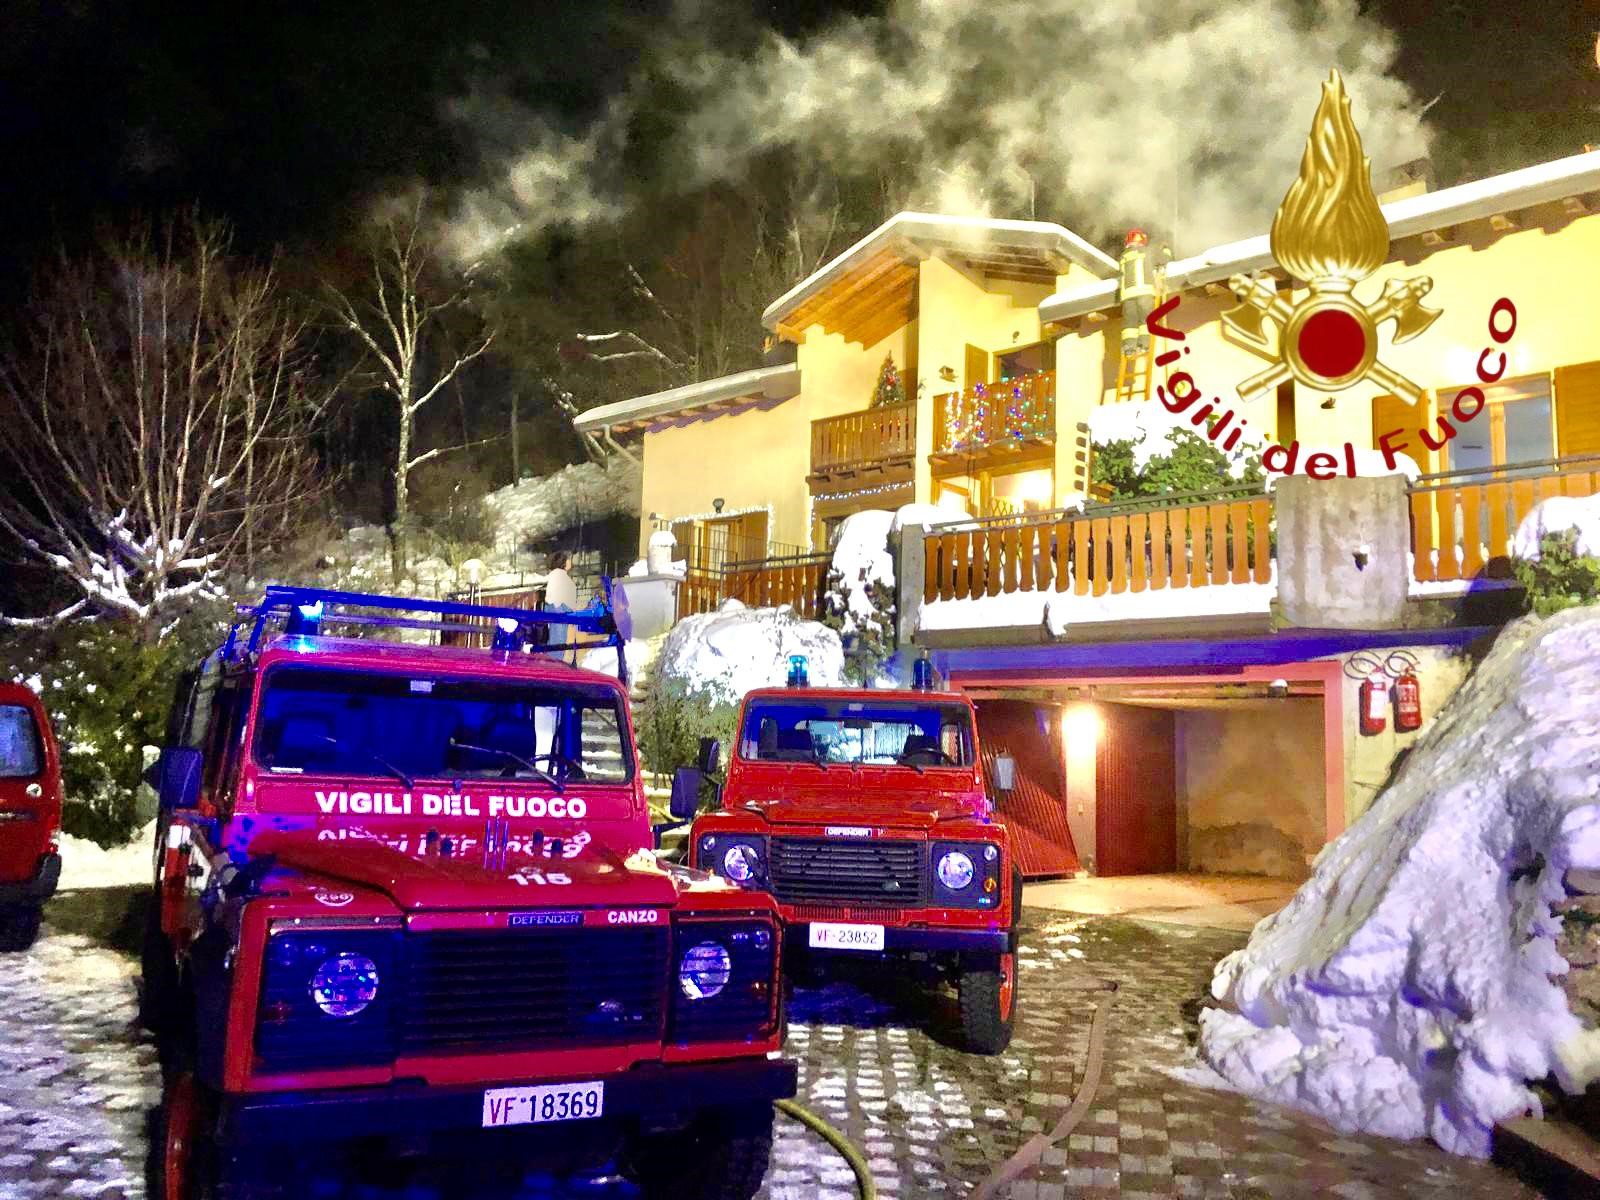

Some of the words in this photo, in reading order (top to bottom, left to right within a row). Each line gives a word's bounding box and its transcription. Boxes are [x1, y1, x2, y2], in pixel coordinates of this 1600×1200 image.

[314, 791, 412, 815] VIGILI
[422, 794, 480, 816] DEL
[489, 795, 587, 819] FUOCO
[508, 873, 572, 886] 115
[512, 914, 580, 925] DEFENDER
[607, 910, 658, 924] CANZO
[838, 930, 878, 944] 23852
[490, 1097, 517, 1124] VF
[529, 1090, 598, 1121] 18369
